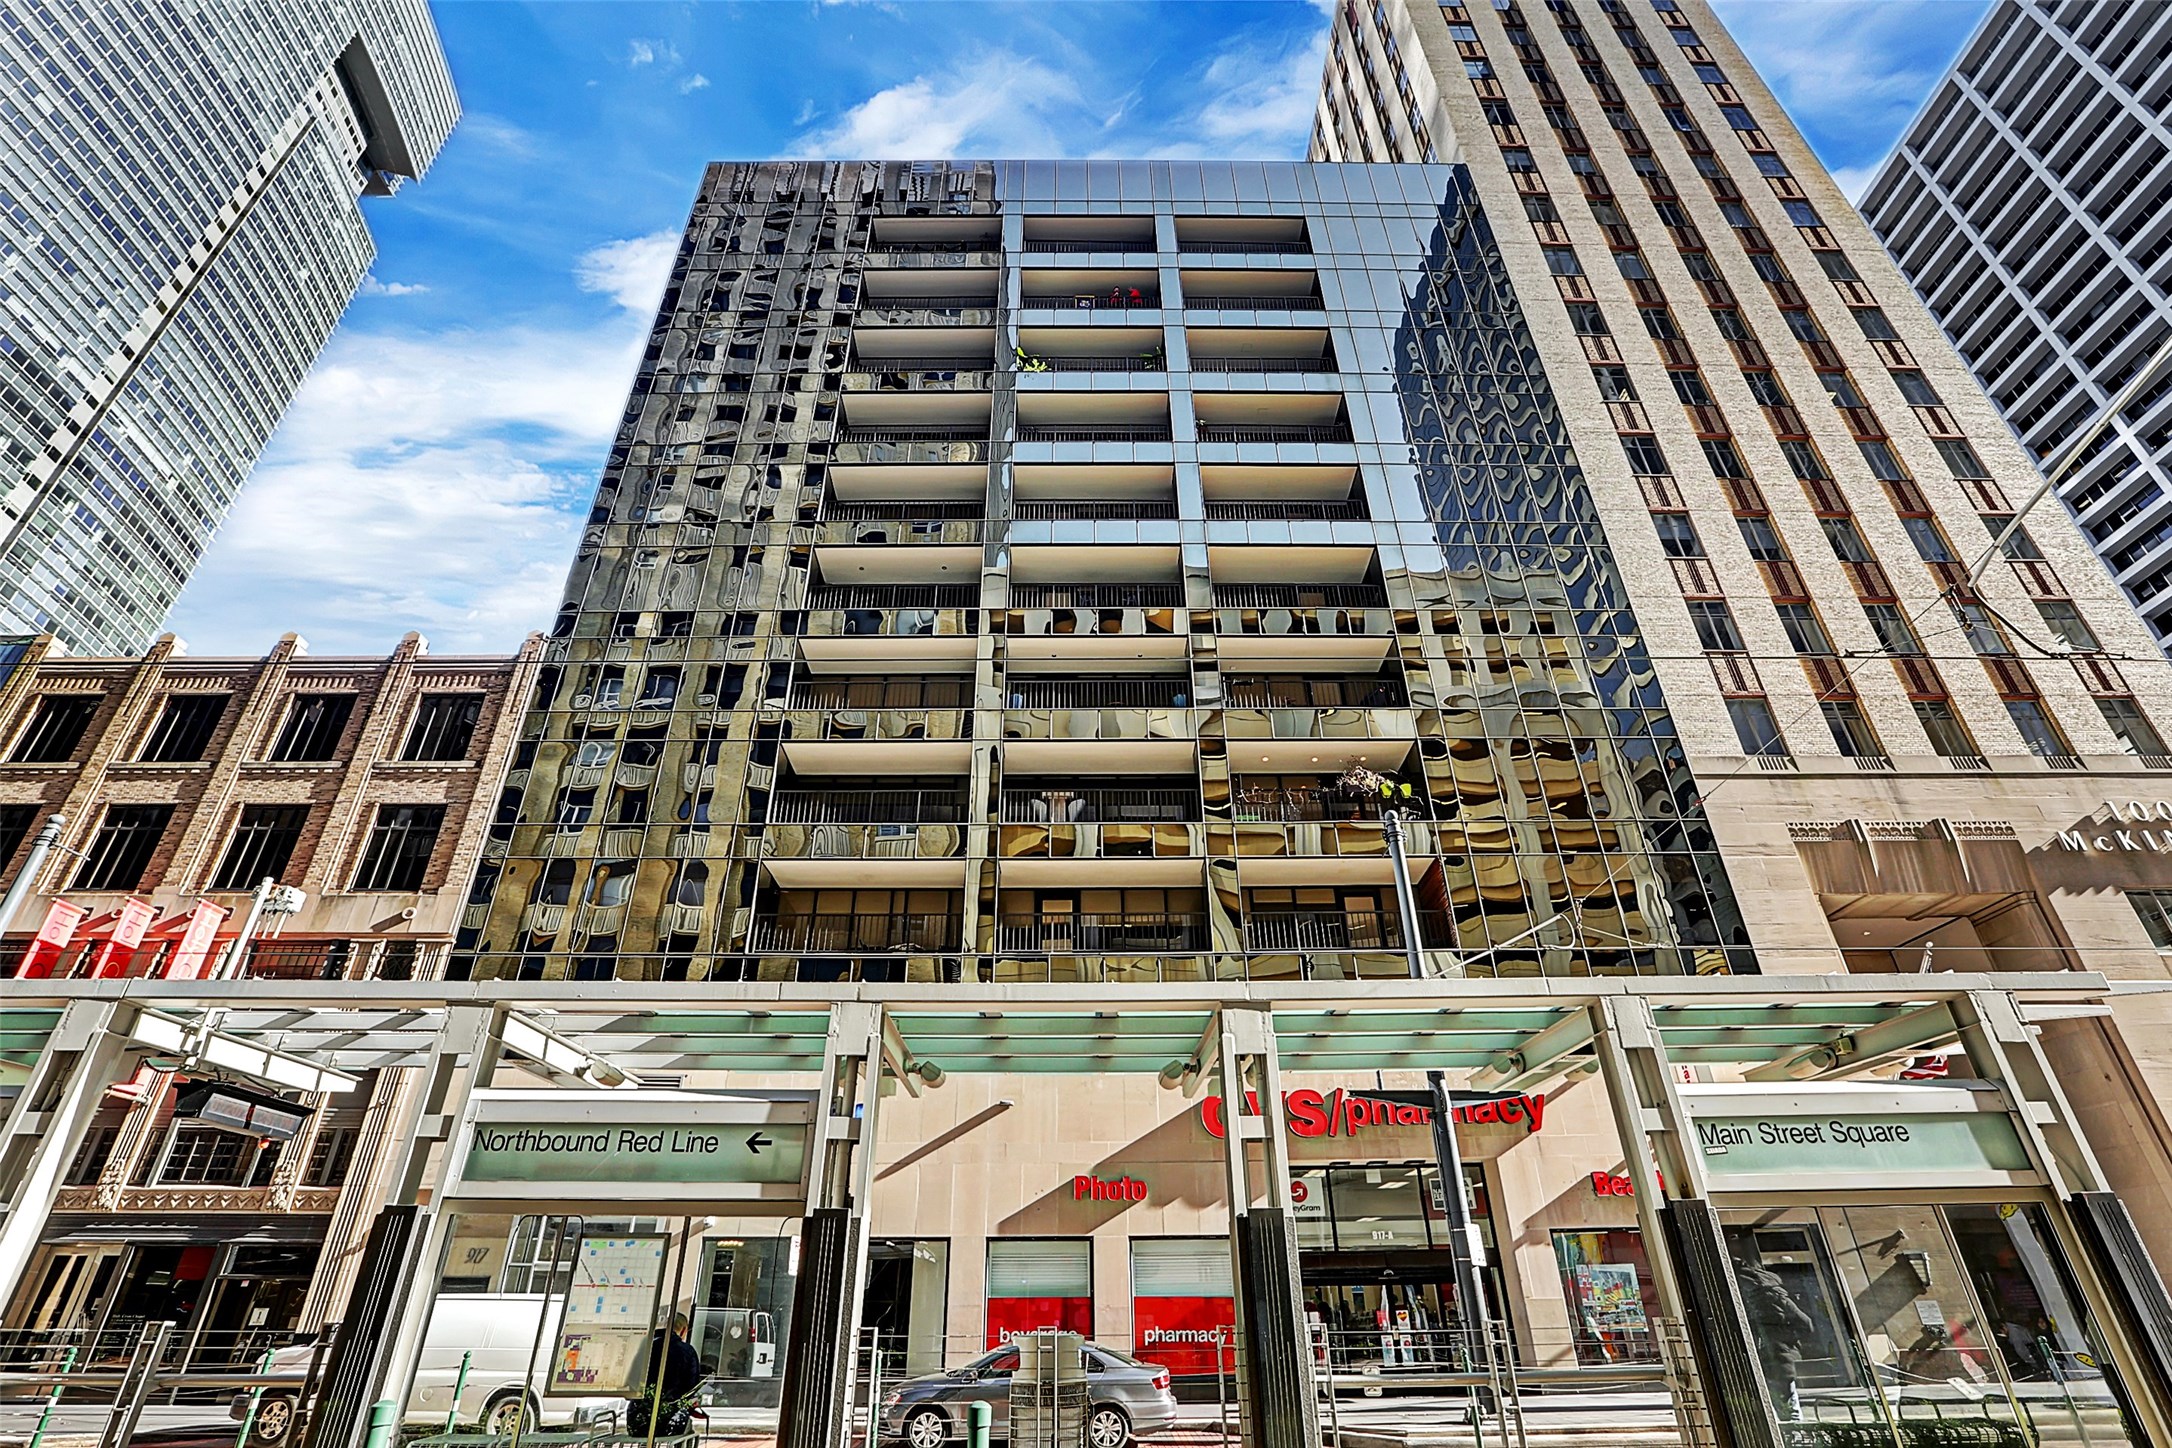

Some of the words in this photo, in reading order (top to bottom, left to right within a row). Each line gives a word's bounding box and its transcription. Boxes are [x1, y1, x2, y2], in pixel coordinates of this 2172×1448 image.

[472, 1128, 611, 1152] Northbound
[616, 1129, 665, 1153] Red
[671, 1130, 719, 1154] Line
[1697, 1122, 1753, 1145] Main
[1757, 1121, 1826, 1145] Street
[1828, 1120, 1910, 1148] Square
[1073, 1174, 1148, 1202] Photo
[1292, 1204, 1321, 1213] eyGram
[1371, 1230, 1394, 1240] 917-A
[463, 1247, 490, 1264] 917
[1144, 1325, 1228, 1346] pharmacy
